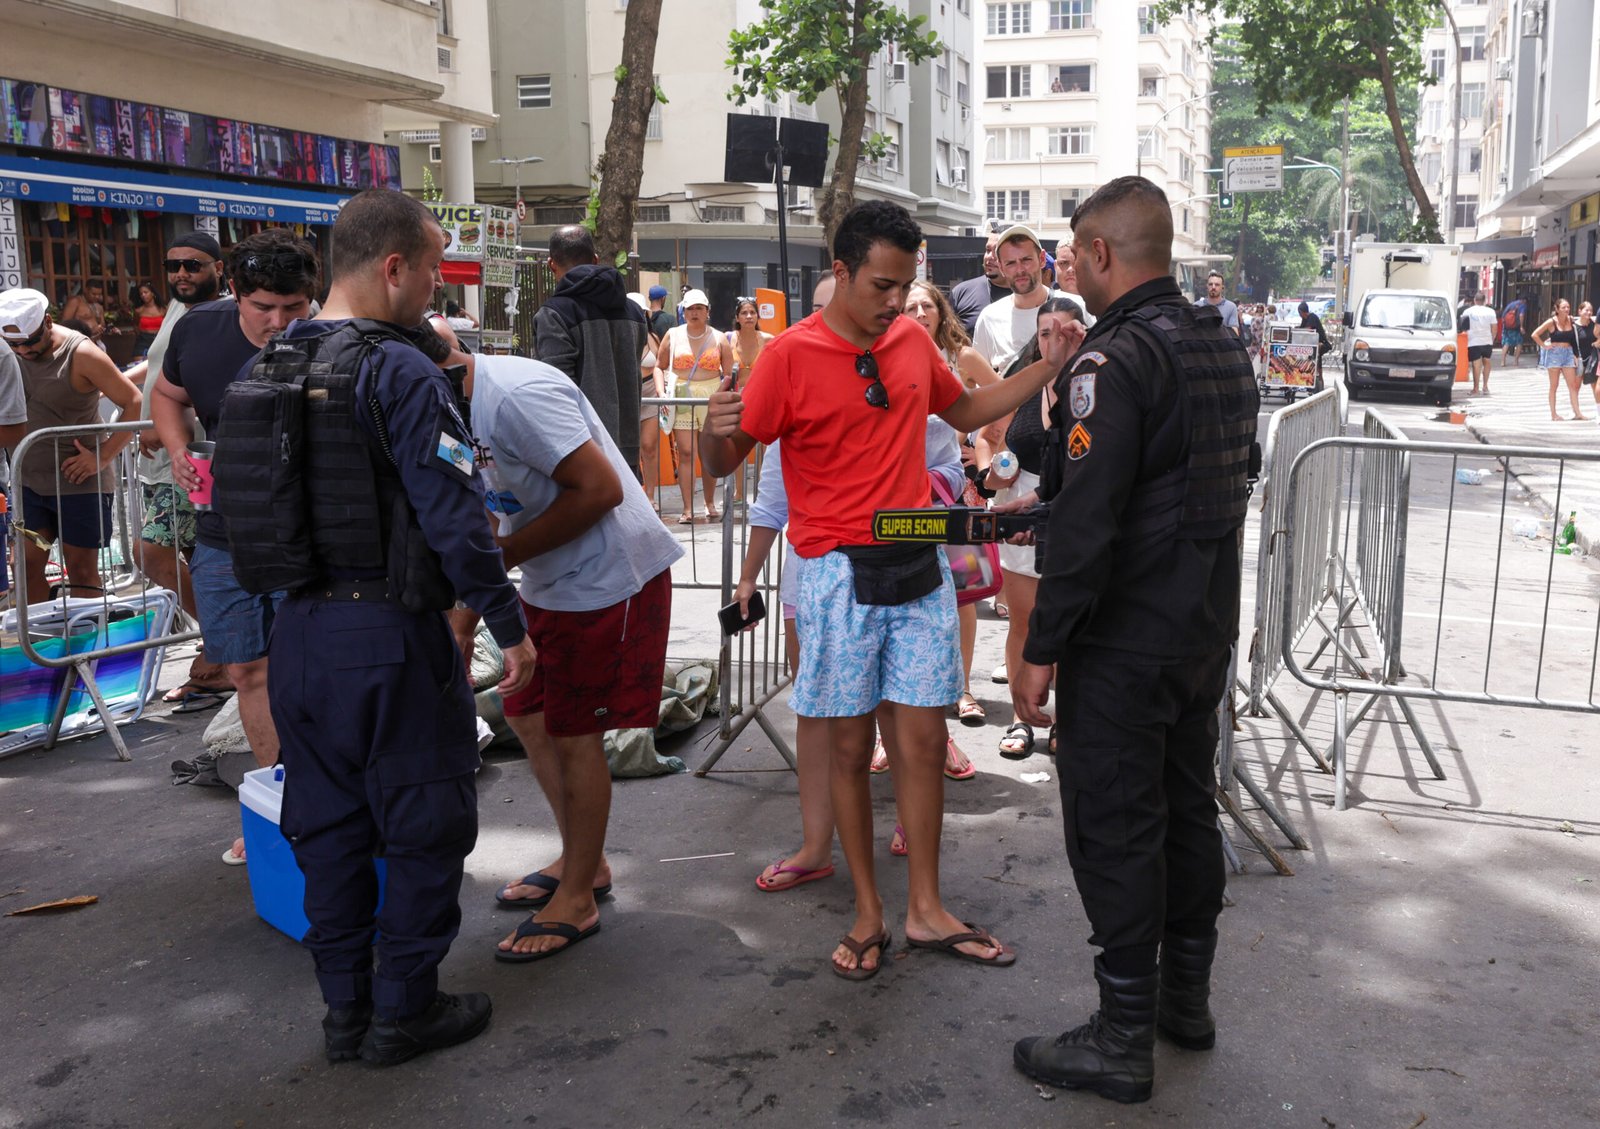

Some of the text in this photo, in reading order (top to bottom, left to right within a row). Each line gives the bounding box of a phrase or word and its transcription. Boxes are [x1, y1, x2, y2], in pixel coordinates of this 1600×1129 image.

[110, 192, 143, 205] KINJO
[230, 204, 257, 216] KINJO
[490, 207, 513, 220] SELF
[457, 245, 481, 253] X-TUDO
[486, 244, 514, 259] SERVICE
[881, 518, 947, 535] SUPER SCANN
